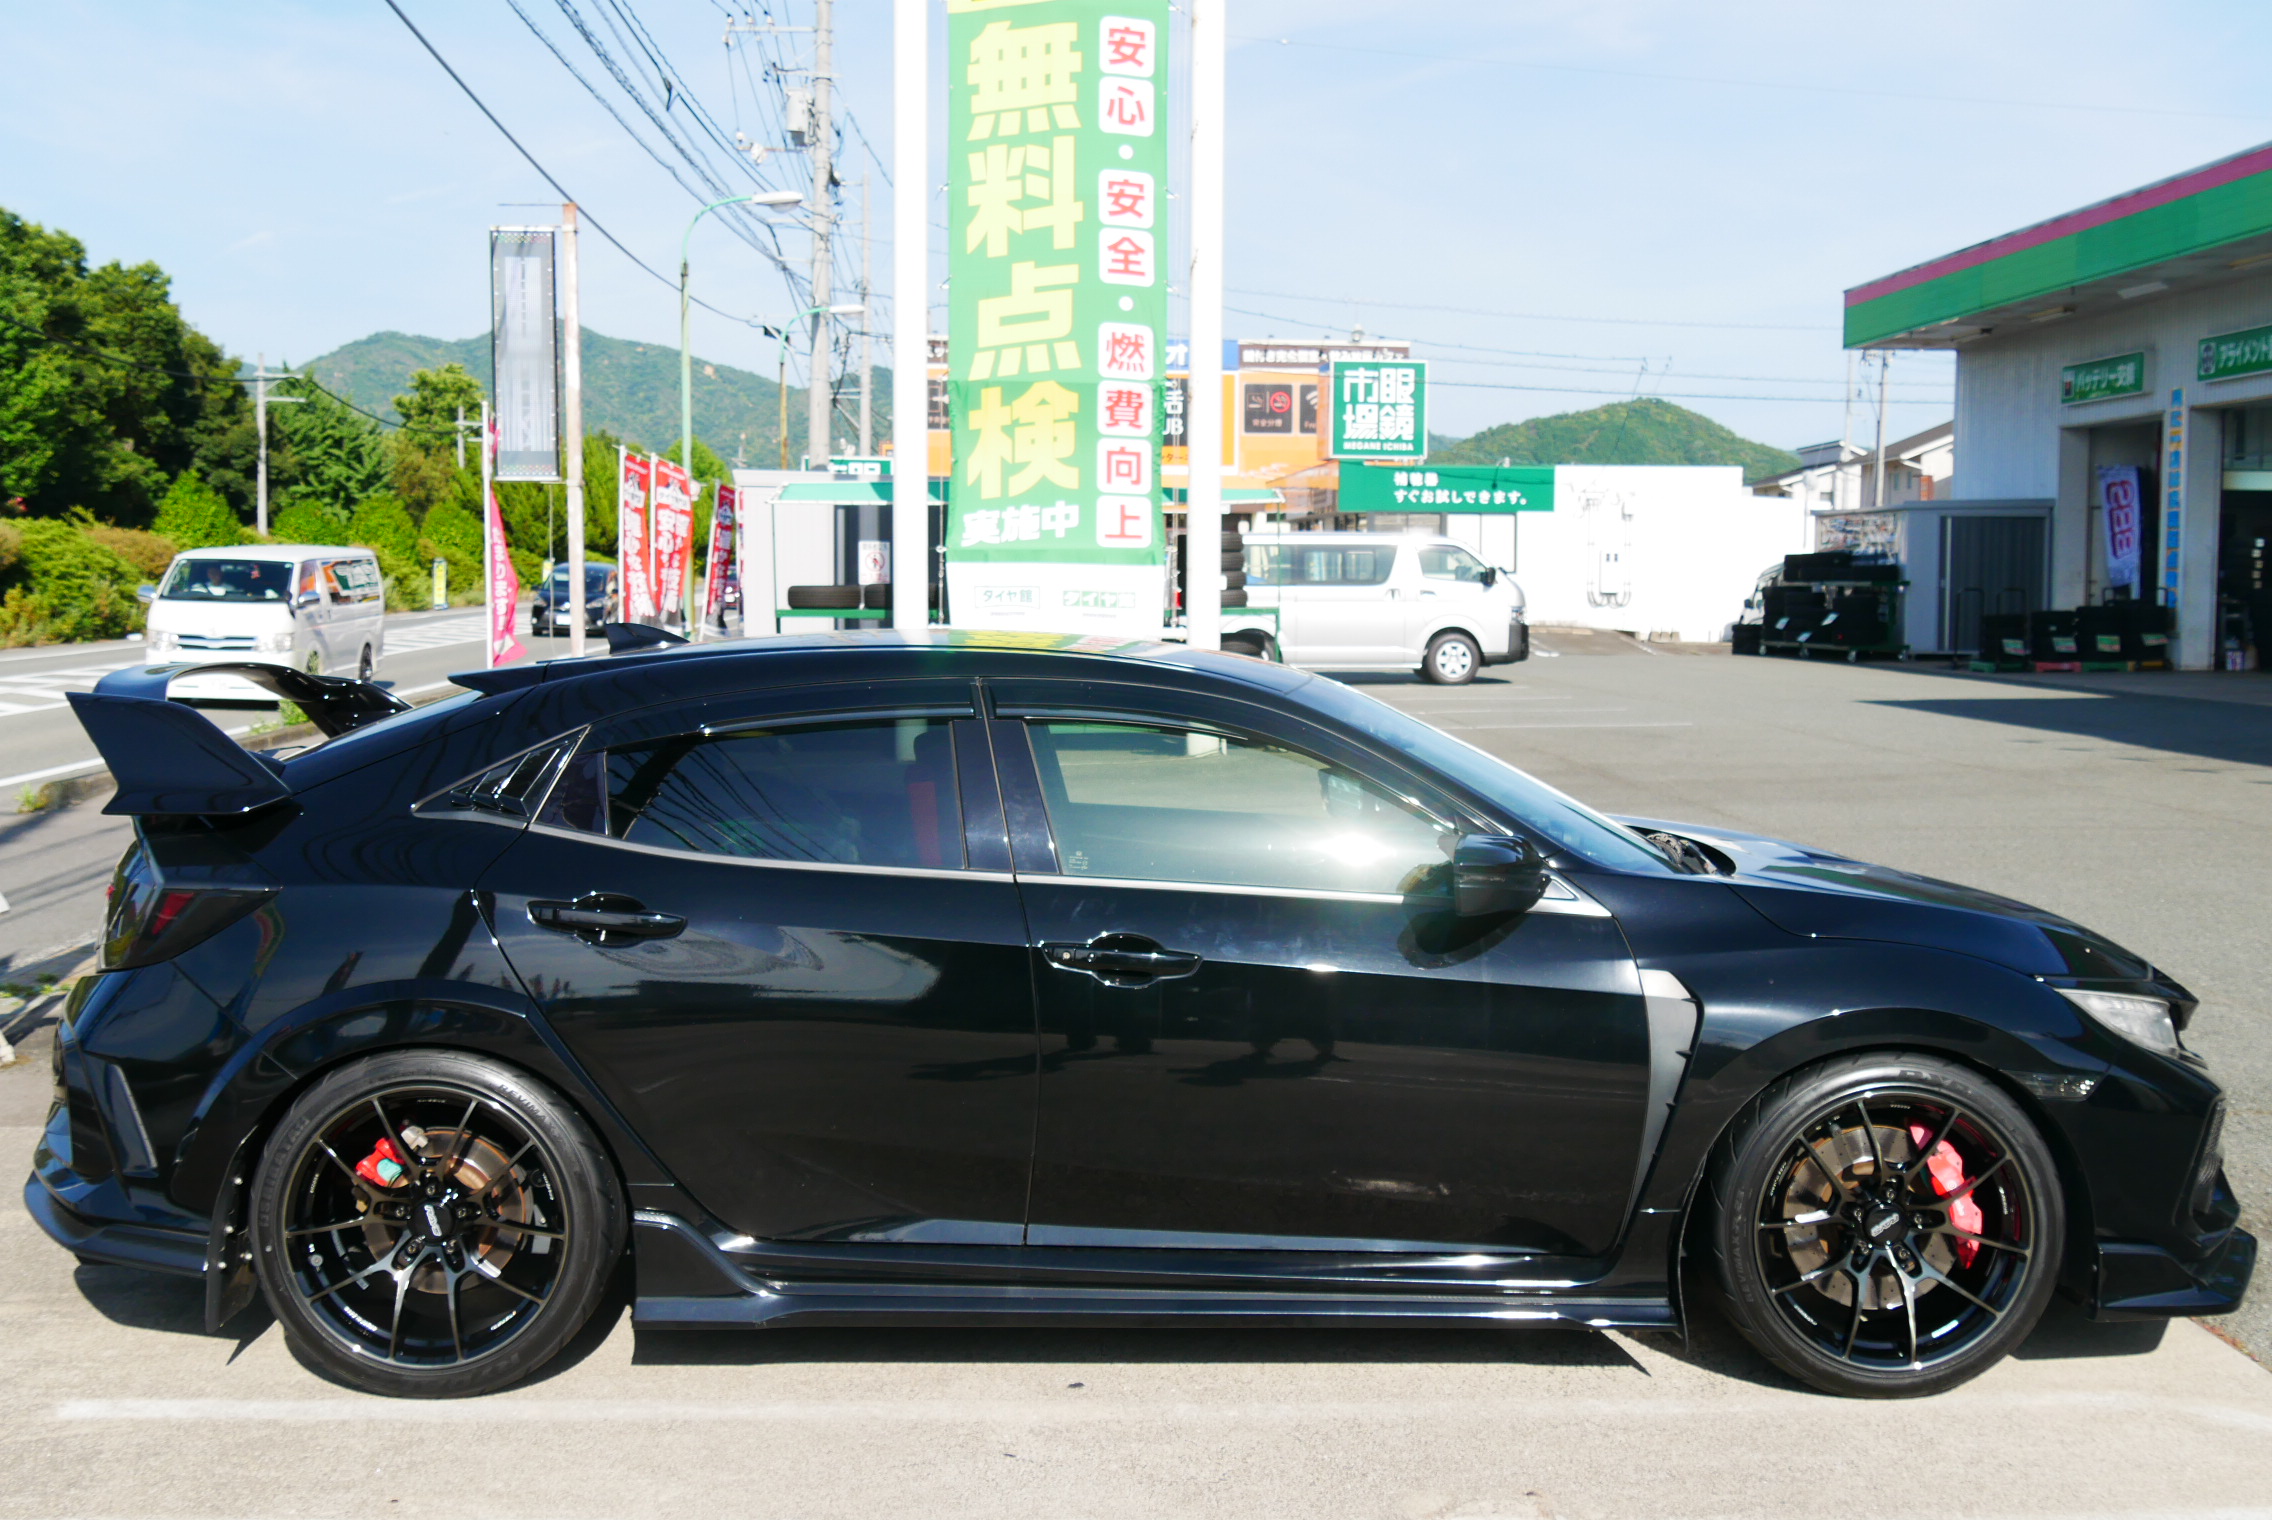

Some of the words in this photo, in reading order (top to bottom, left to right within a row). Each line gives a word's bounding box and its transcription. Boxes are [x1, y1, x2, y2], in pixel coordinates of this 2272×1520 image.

[966, 20, 1083, 499] 無料点検
[2219, 335, 2272, 369] アライメント
[1393, 489, 1527, 505] すぐお試しできます。
[961, 500, 1079, 547] 実施中
